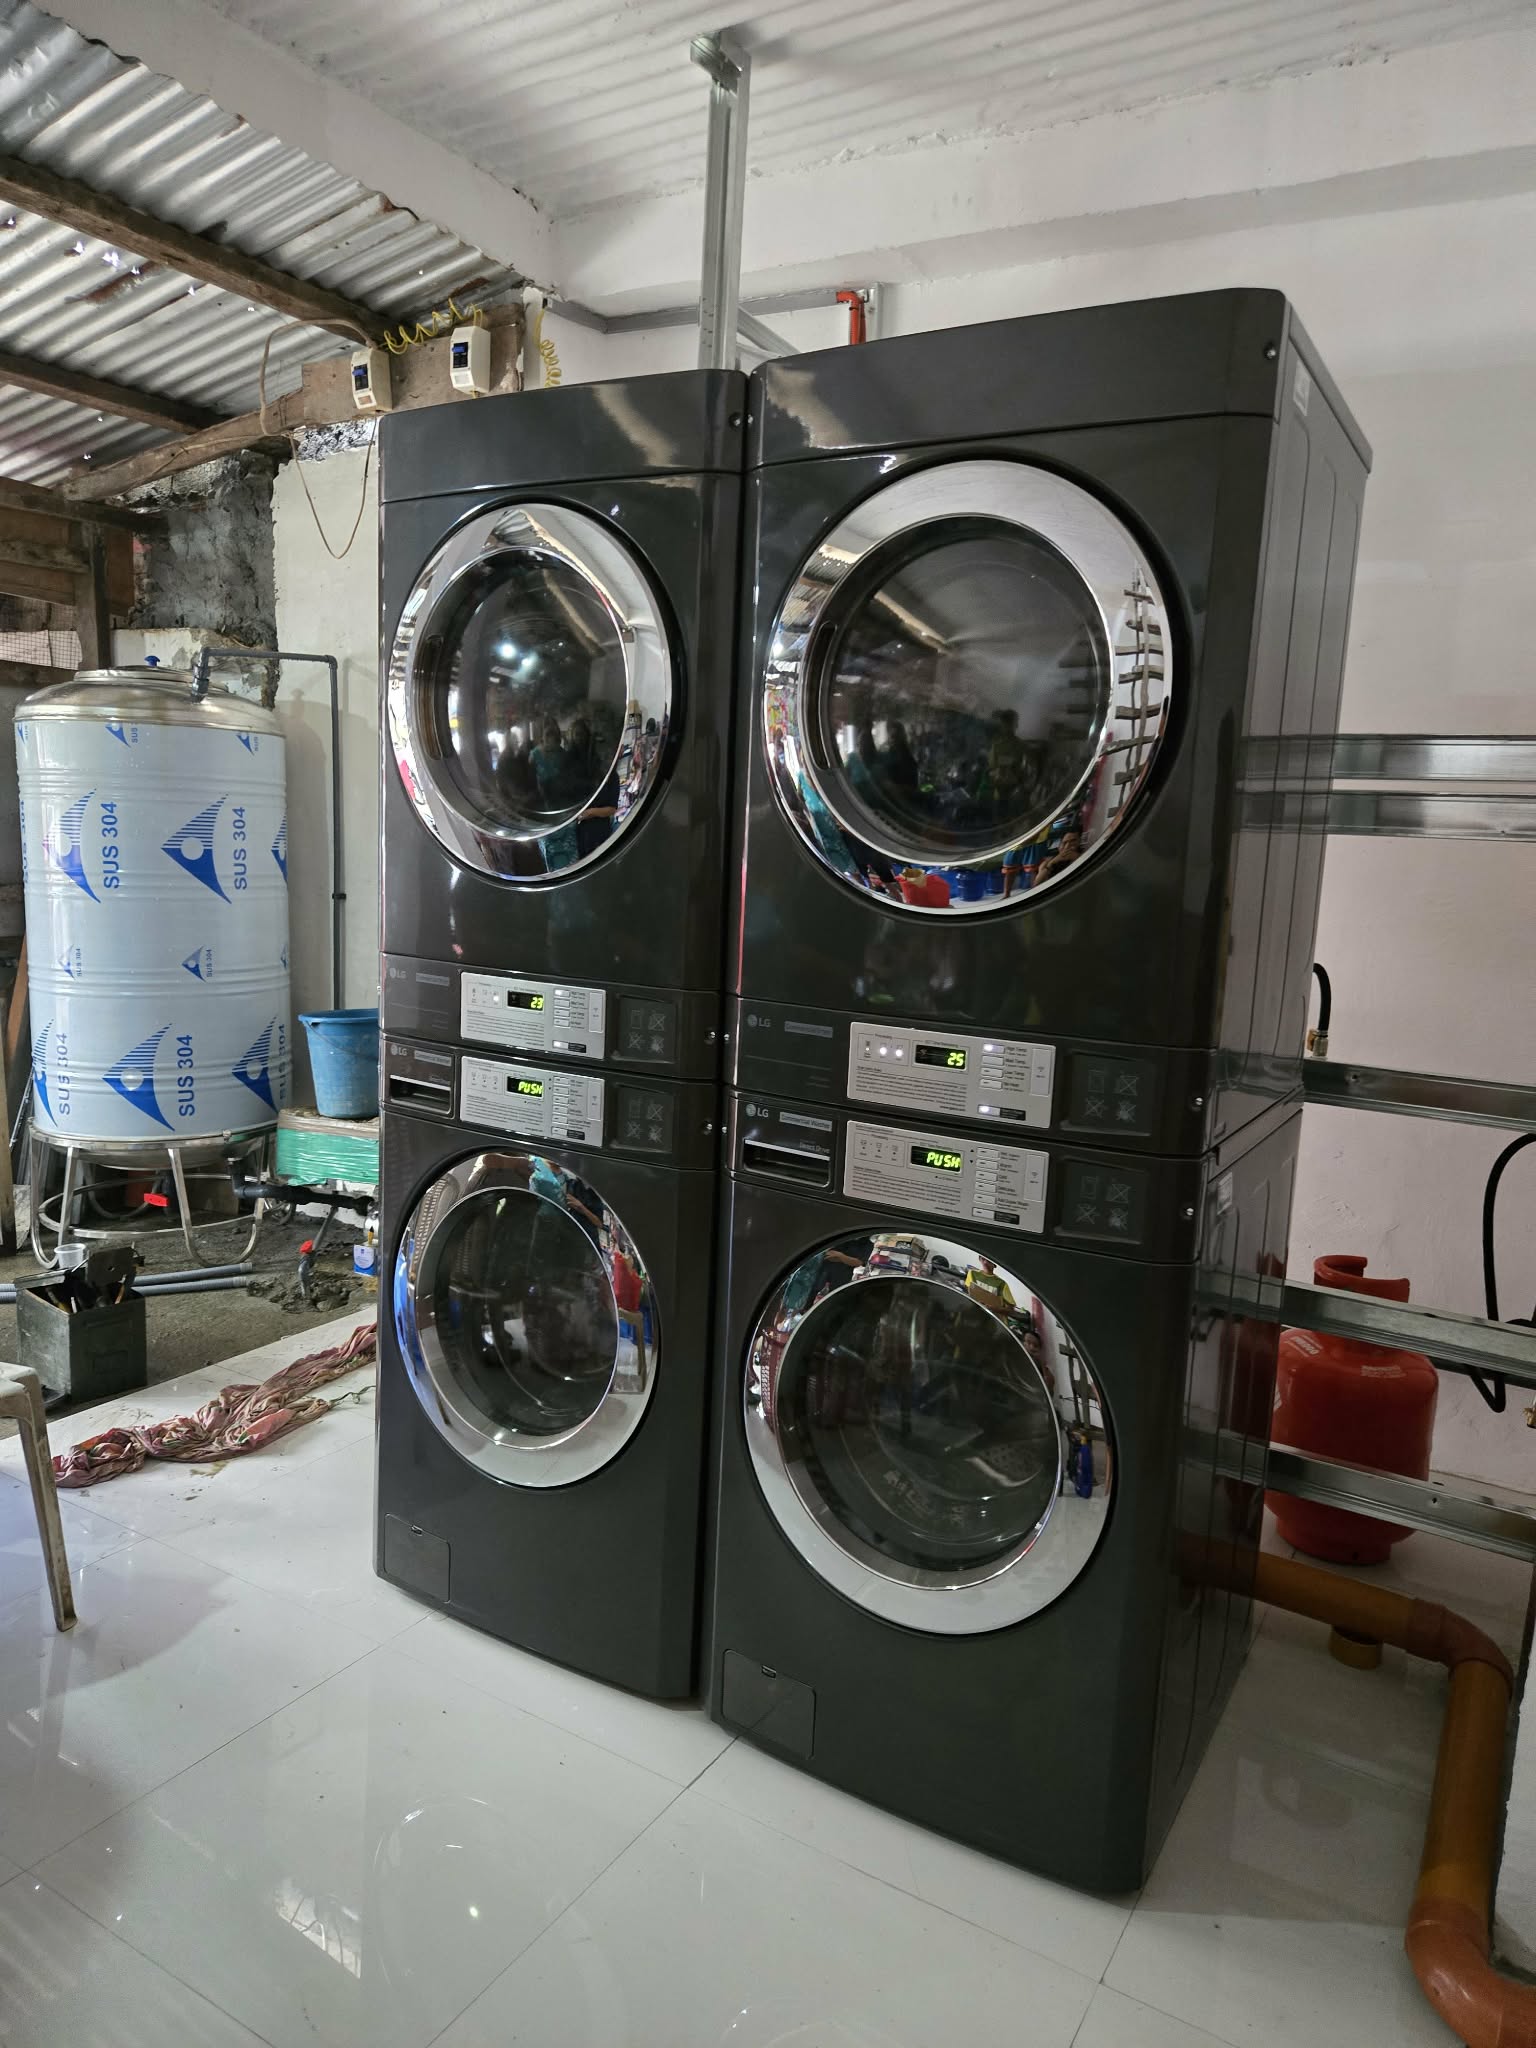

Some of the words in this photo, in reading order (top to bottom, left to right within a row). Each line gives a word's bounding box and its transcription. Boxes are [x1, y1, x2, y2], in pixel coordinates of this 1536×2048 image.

[101, 801, 118, 839] 304
[232, 806, 246, 841] 304
[103, 844, 120, 889] SUS
[233, 848, 248, 890] SUS
[530, 996, 544, 1009] 23
[758, 1017, 771, 1027] LG
[56, 1033, 68, 1068] 304
[176, 1034, 193, 1069] 304
[398, 1047, 407, 1056] LG
[947, 1052, 965, 1067] 25
[58, 1072, 71, 1116] SUS
[178, 1075, 195, 1117] SUS
[518, 1081, 544, 1095] PUSH
[757, 1107, 769, 1118] LG
[926, 1151, 961, 1168] PUSH
